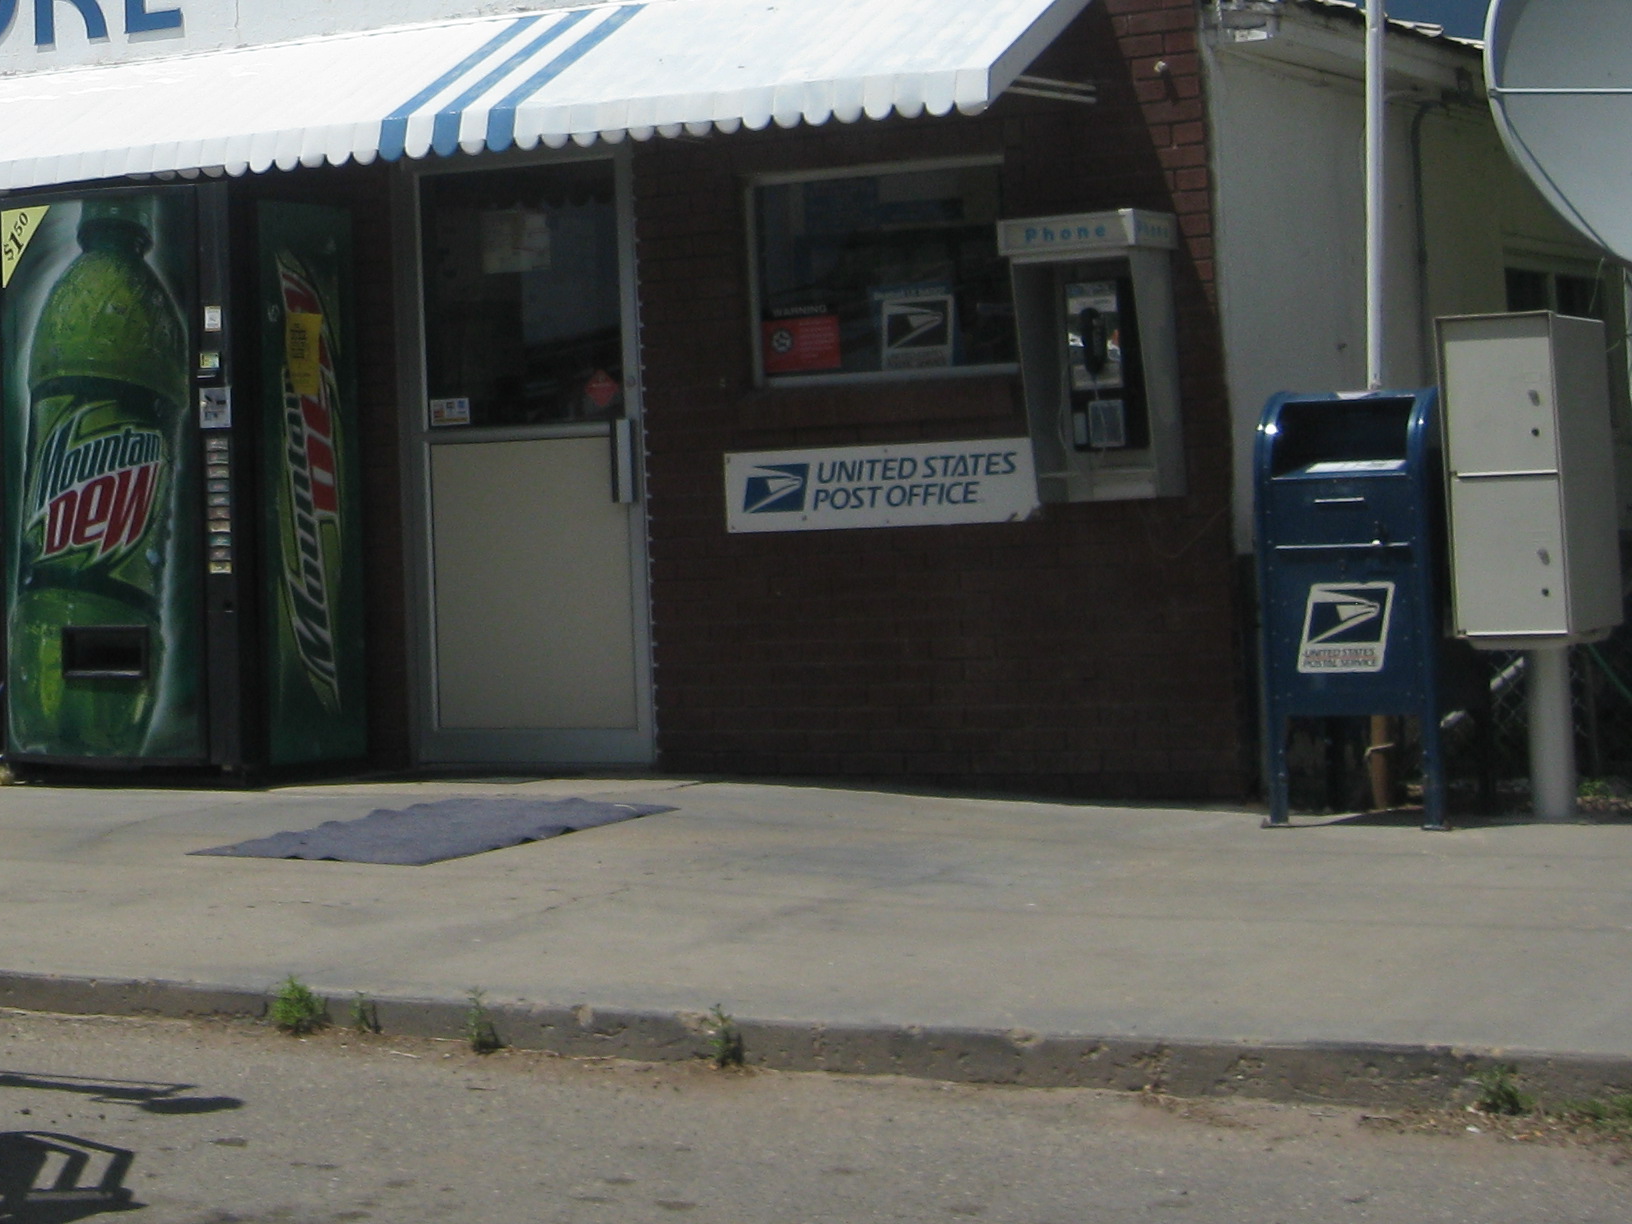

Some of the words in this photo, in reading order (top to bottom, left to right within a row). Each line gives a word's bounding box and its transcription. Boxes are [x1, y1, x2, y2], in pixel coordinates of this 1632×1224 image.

[1024, 224, 1107, 243] Phone
[772, 304, 827, 317] WARNING
[36, 417, 161, 511] Mountain
[817, 457, 918, 484] UNITED
[921, 452, 1018, 478] STATES
[813, 486, 884, 511] POST
[887, 482, 982, 506] OFFICE
[1304, 648, 1340, 657] UNITED
[1342, 647, 1375, 656] STATES
[1304, 660, 1338, 668] POSTAL
[1339, 659, 1377, 667] SERVICE
